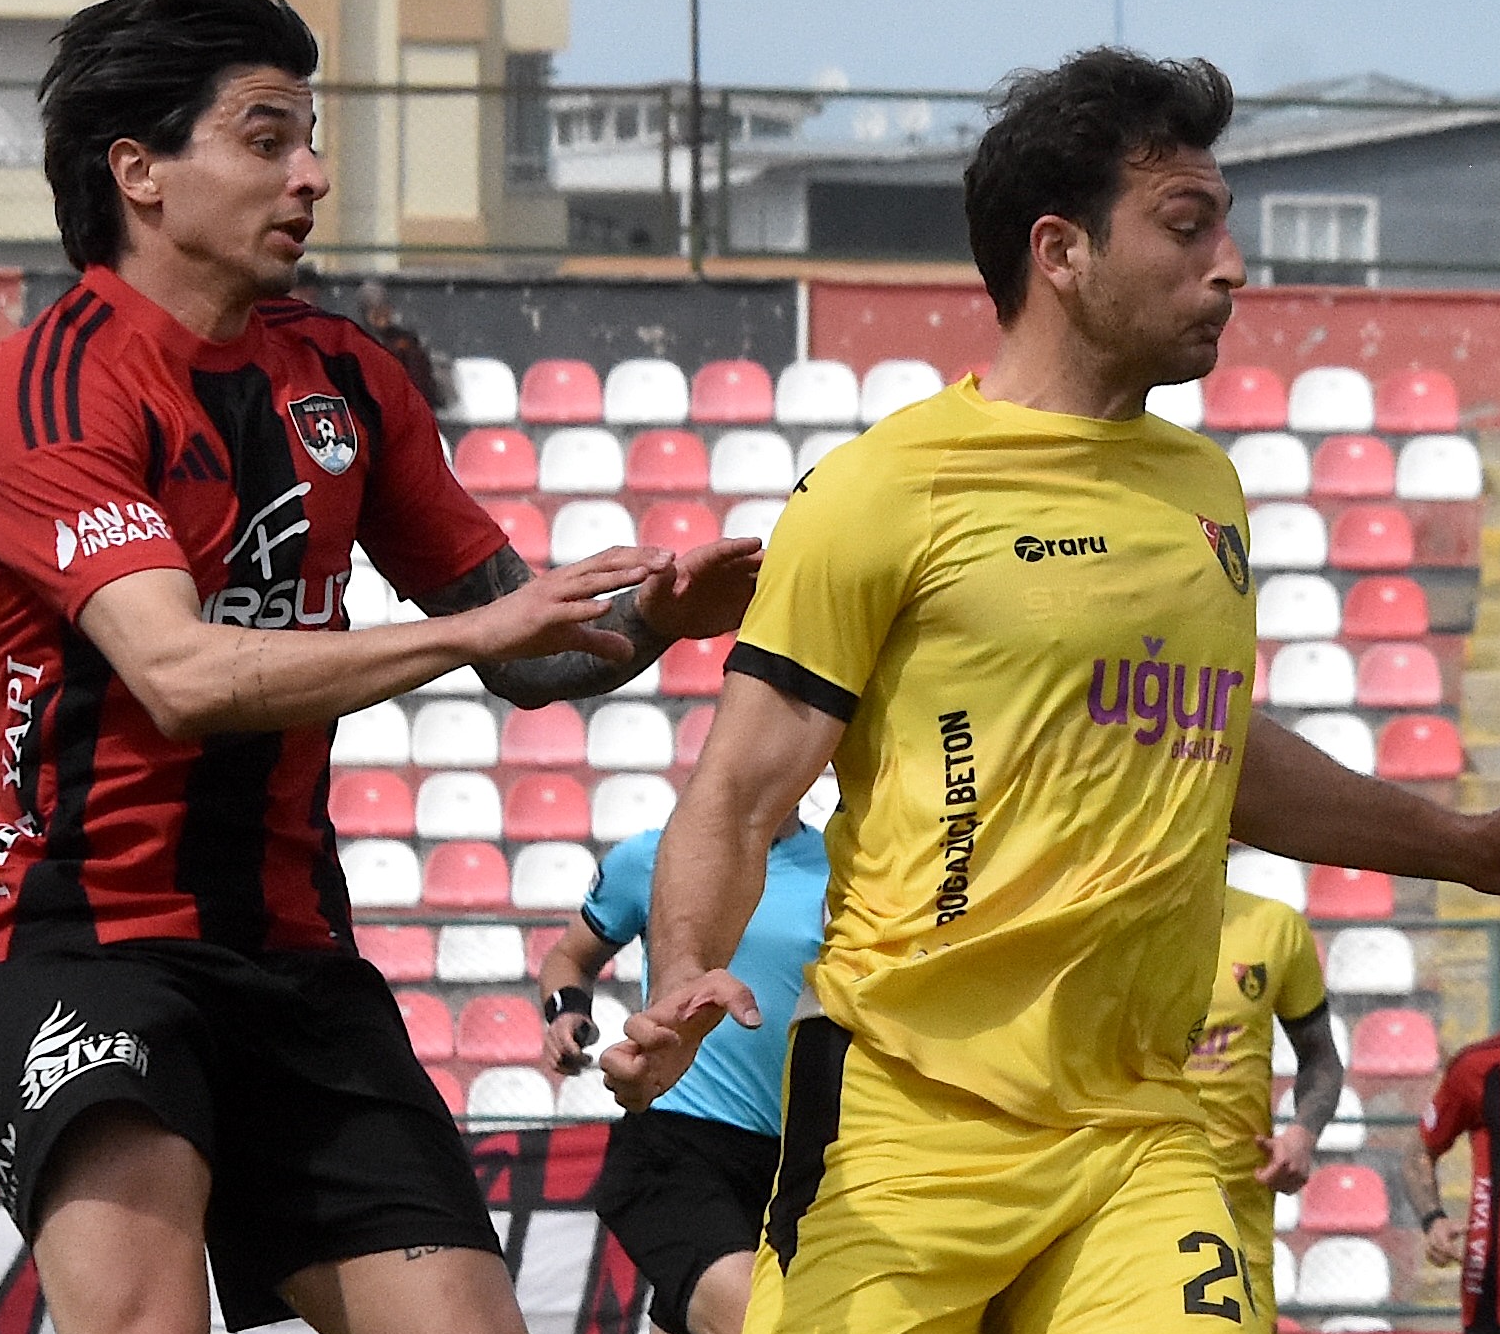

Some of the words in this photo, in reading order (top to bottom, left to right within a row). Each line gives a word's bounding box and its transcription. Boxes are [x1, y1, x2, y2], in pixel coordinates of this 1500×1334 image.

[1044, 535, 1108, 557] raru
[1, 654, 45, 790] YAPI
[1086, 635, 1244, 746] uğur
[938, 709, 979, 807] BETON
[1176, 1230, 1258, 1324] 2
